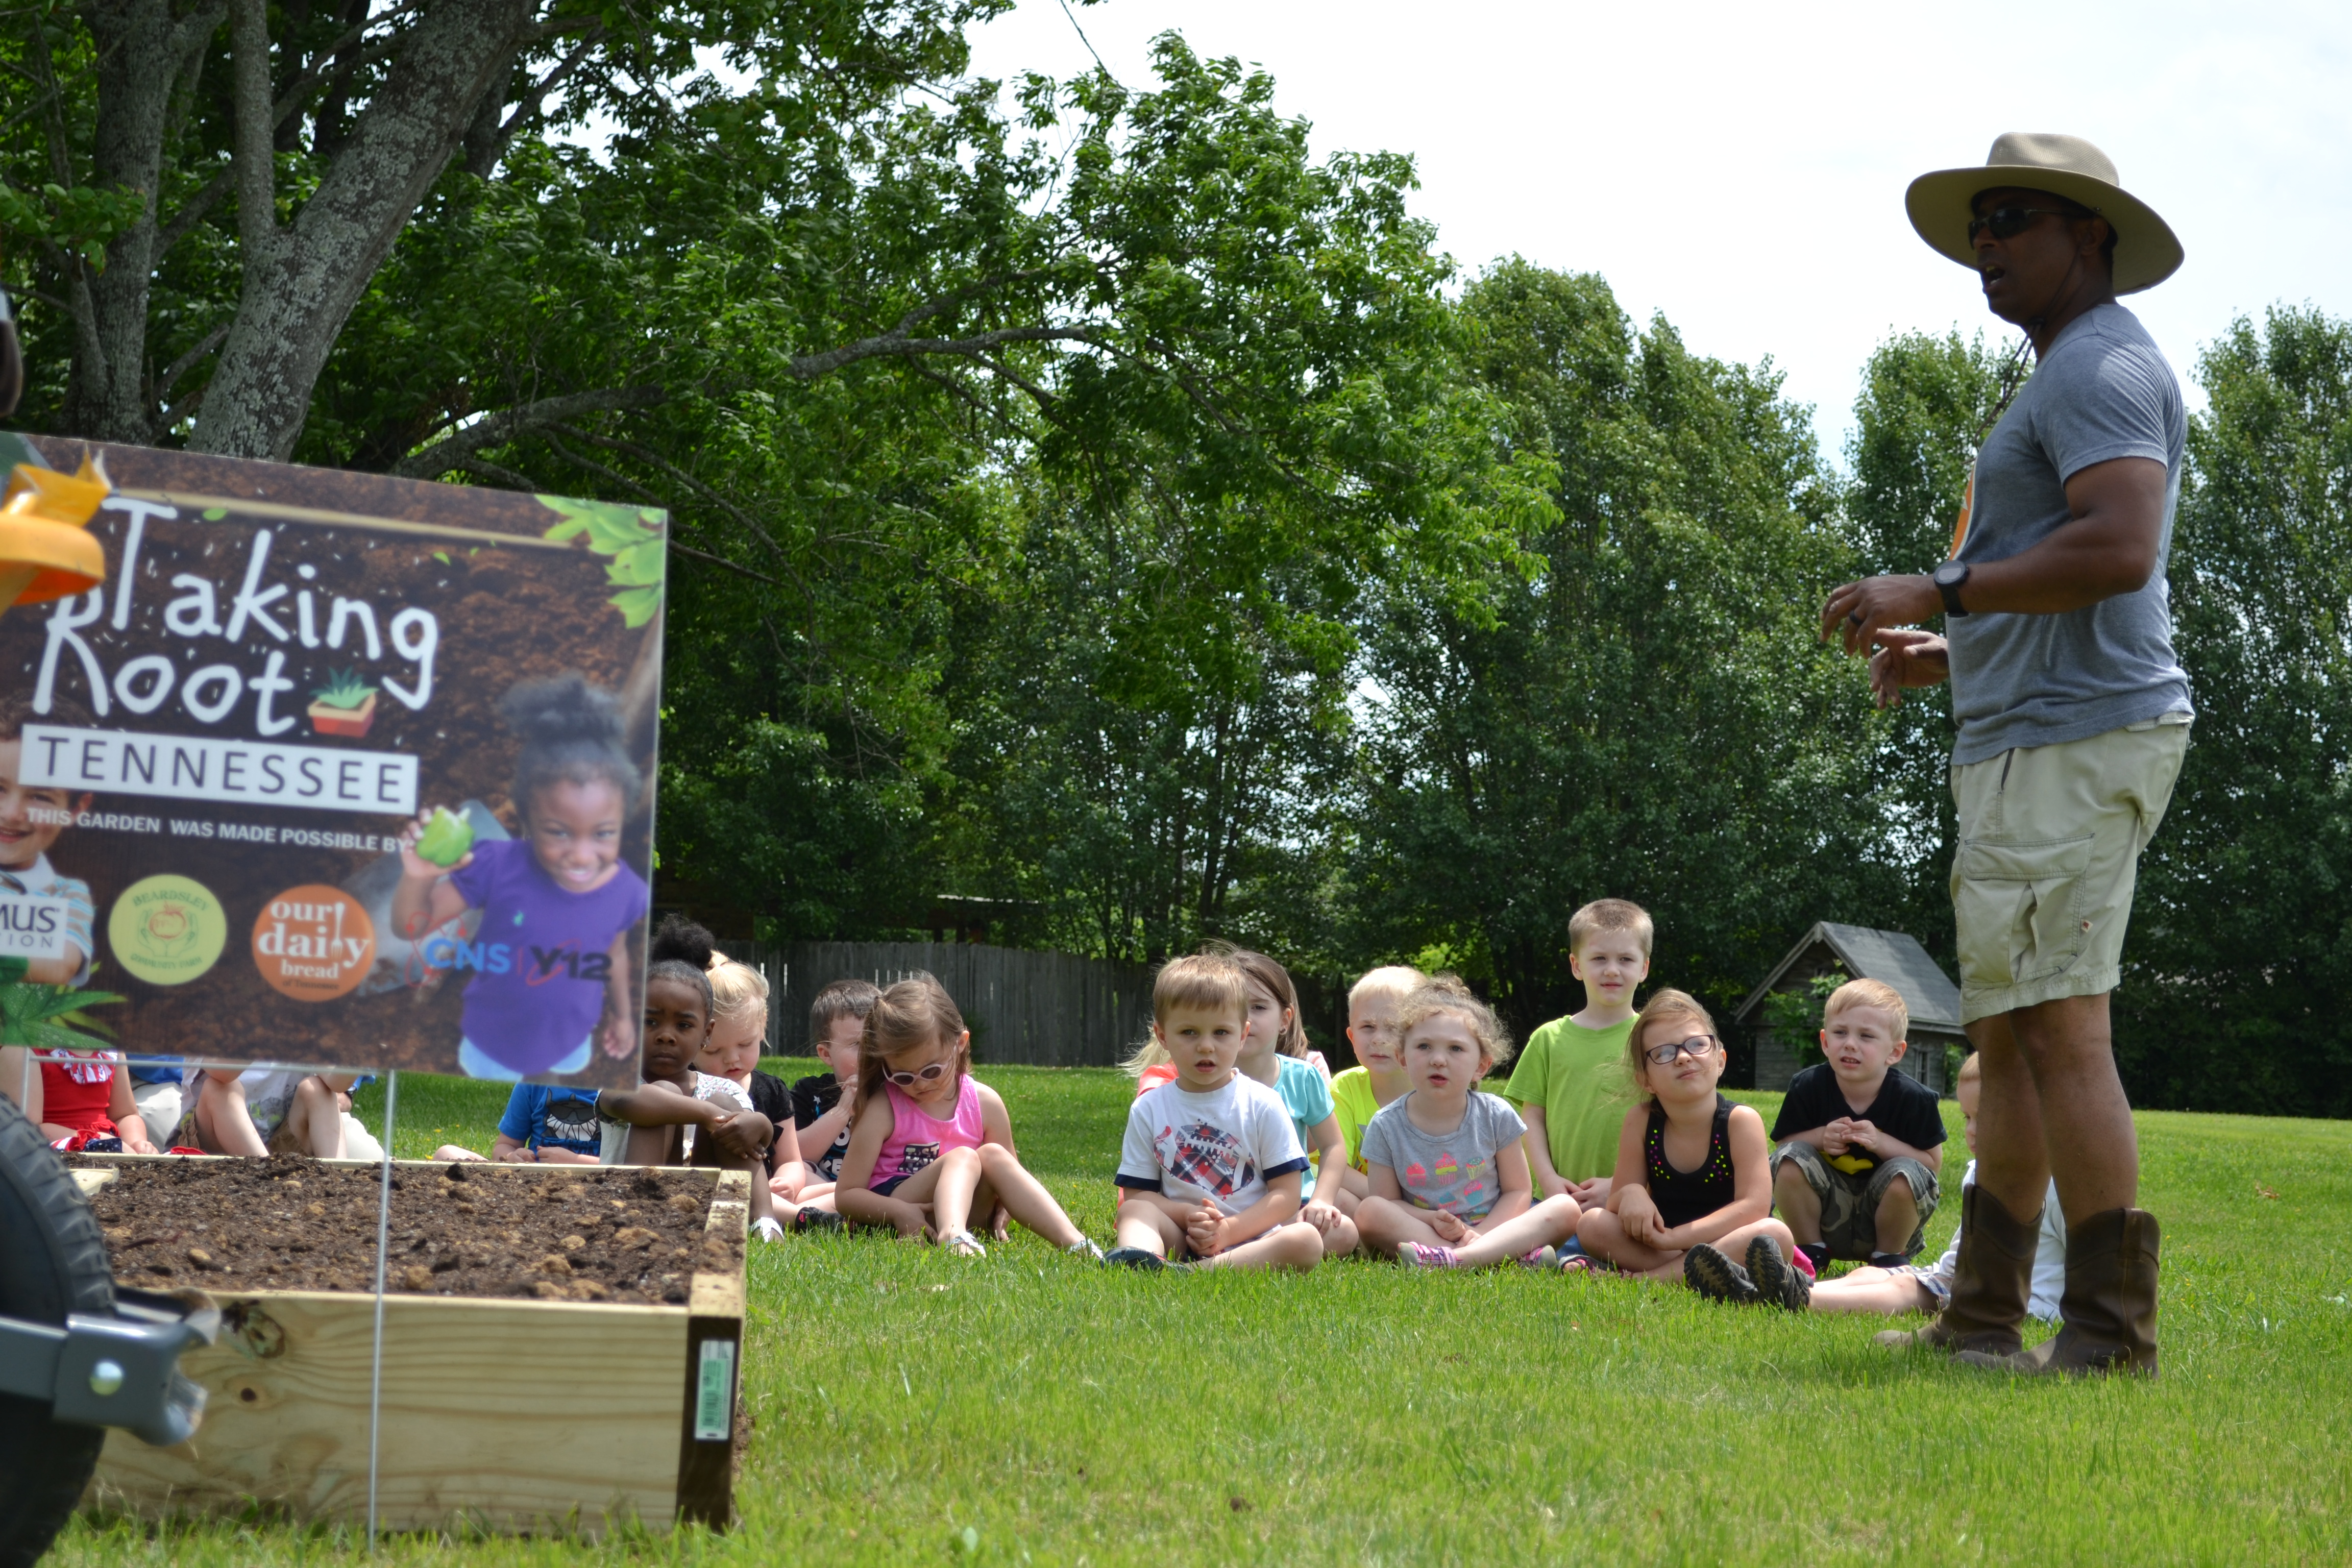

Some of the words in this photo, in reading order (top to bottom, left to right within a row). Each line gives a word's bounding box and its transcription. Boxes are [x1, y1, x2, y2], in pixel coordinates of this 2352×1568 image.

[101, 497, 438, 710] Taking
[33, 586, 296, 736] Root
[38, 736, 402, 804] TENNESSEE
[27, 807, 71, 826] THIS
[77, 812, 161, 833] GARDEN
[170, 819, 214, 837] WAS
[218, 823, 277, 843] MADE
[280, 828, 378, 850] POSSIBLE
[132, 890, 210, 911] BEARDSLEY
[271, 901, 334, 922] our
[258, 902, 371, 968] daily
[281, 958, 339, 979] bread
[426, 938, 511, 974] CNS
[529, 945, 612, 983] Y12
